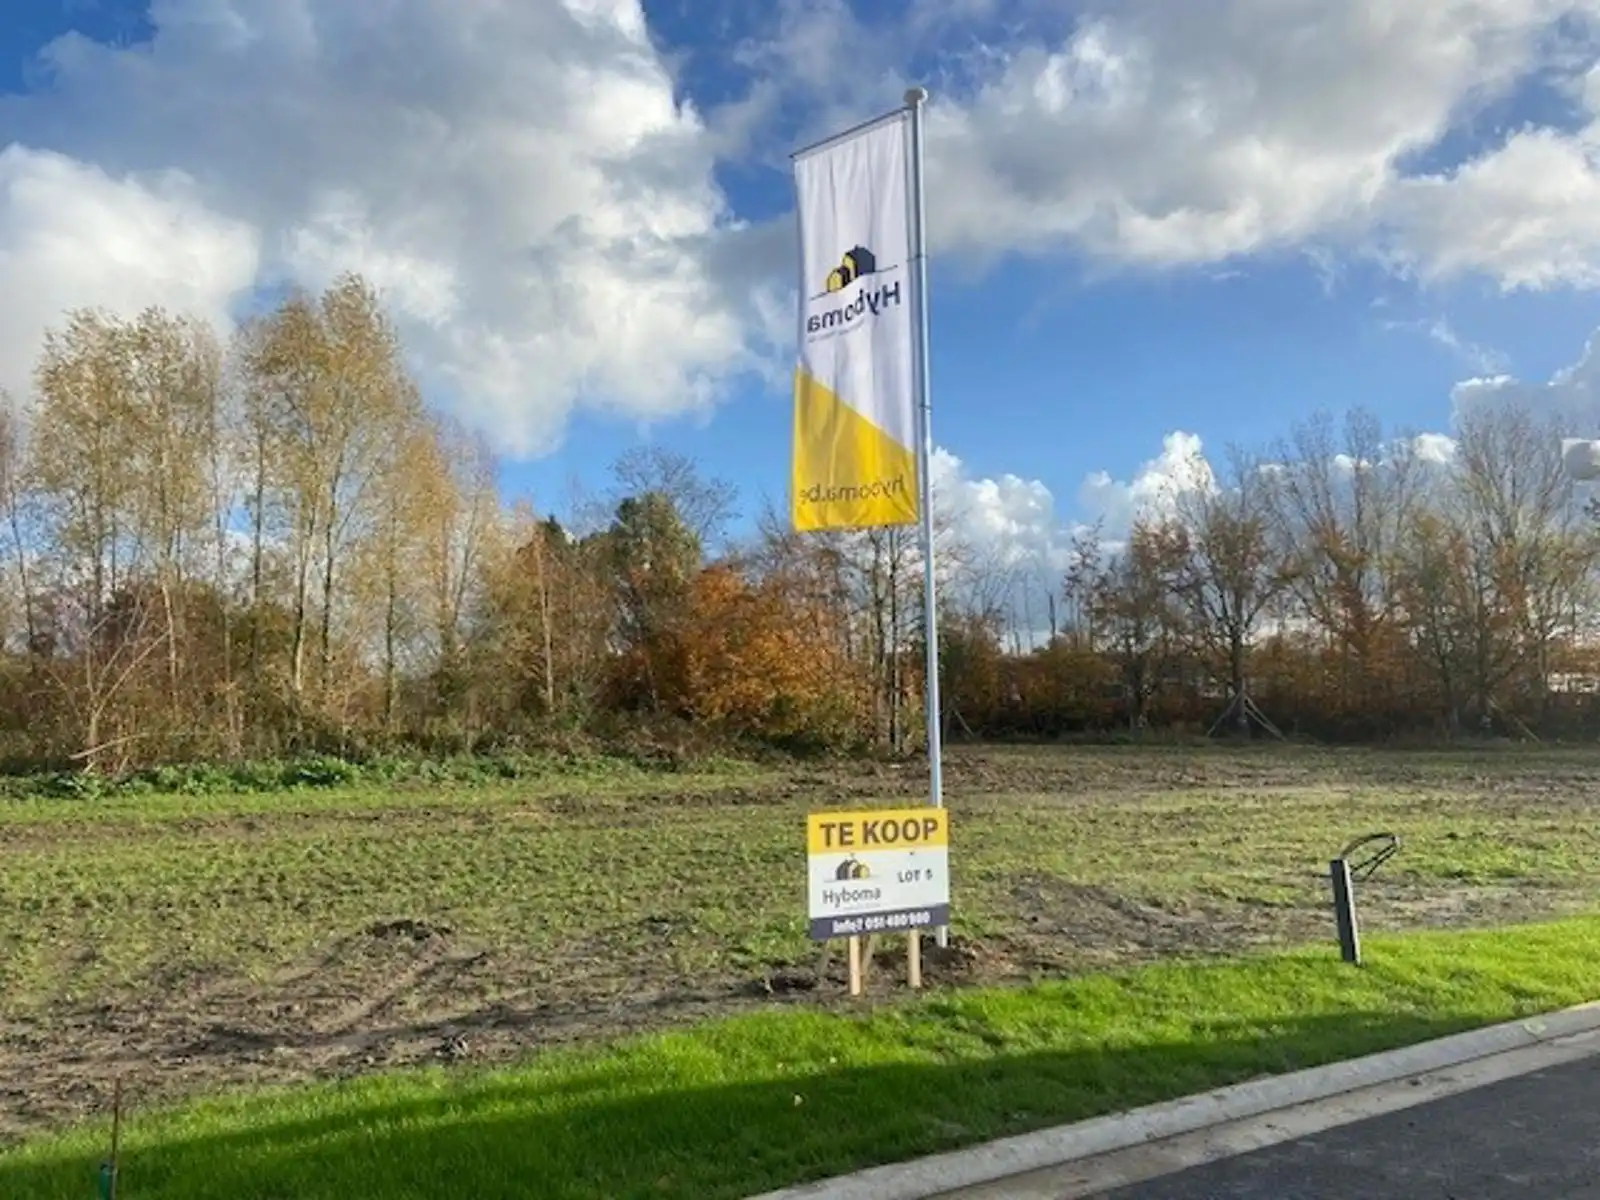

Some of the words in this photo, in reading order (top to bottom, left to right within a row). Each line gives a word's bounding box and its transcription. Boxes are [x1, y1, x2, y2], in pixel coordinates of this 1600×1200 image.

[819, 821, 855, 848] TE
[861, 817, 939, 845] KOOP
[896, 869, 921, 884] LOT
[822, 887, 882, 908] Hyboma
